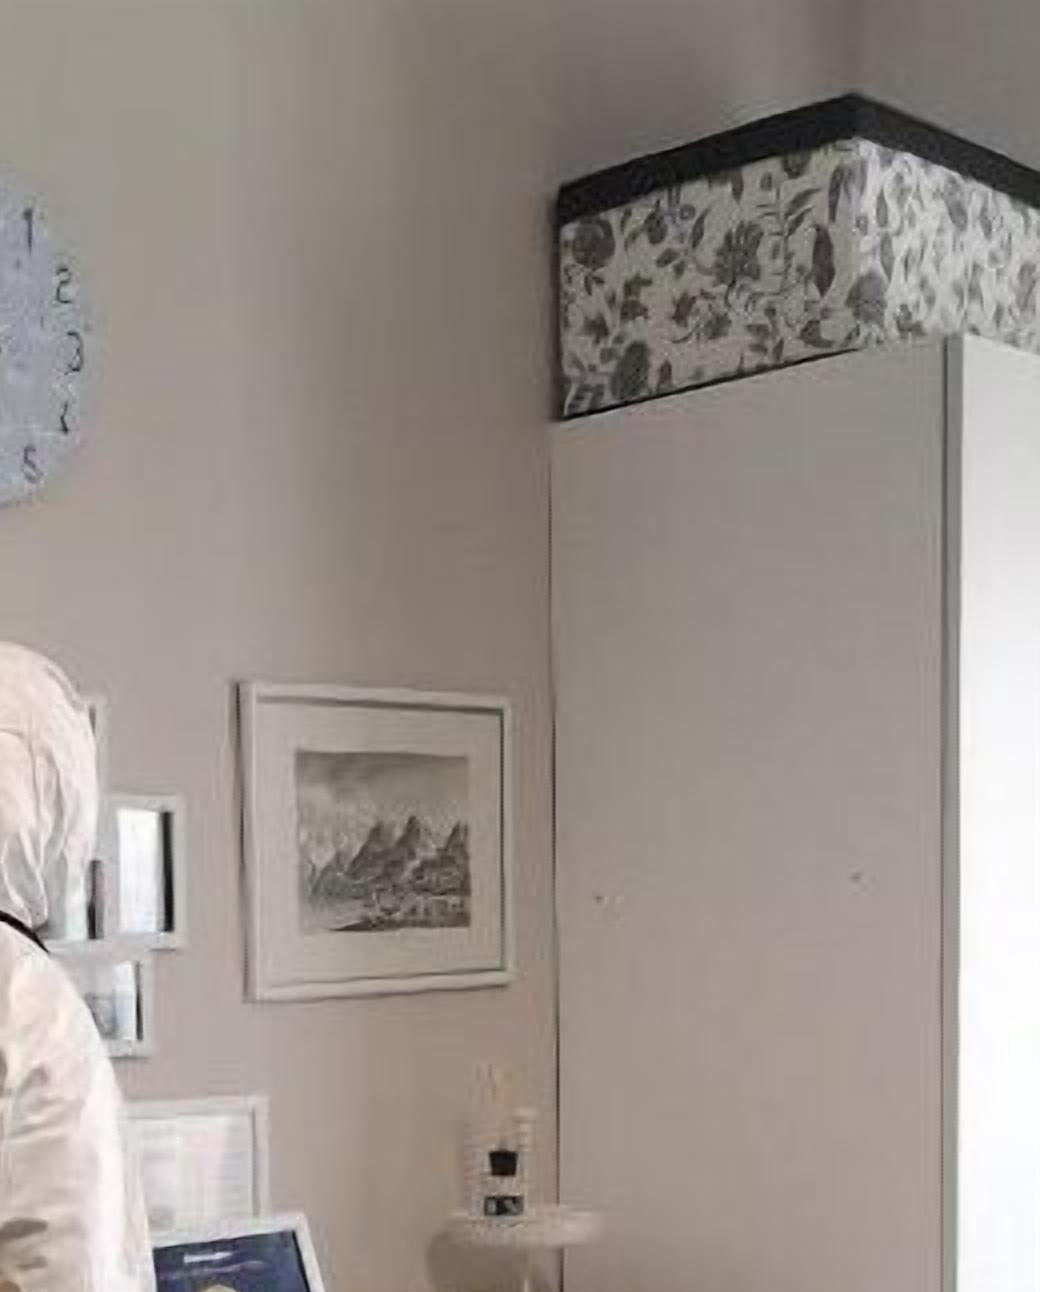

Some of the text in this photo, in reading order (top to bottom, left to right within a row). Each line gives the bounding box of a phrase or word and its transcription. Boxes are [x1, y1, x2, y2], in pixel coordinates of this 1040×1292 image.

[22, 208, 34, 250] 1
[55, 267, 73, 304] 2
[61, 331, 85, 375] 3
[22, 445, 44, 484] 5
